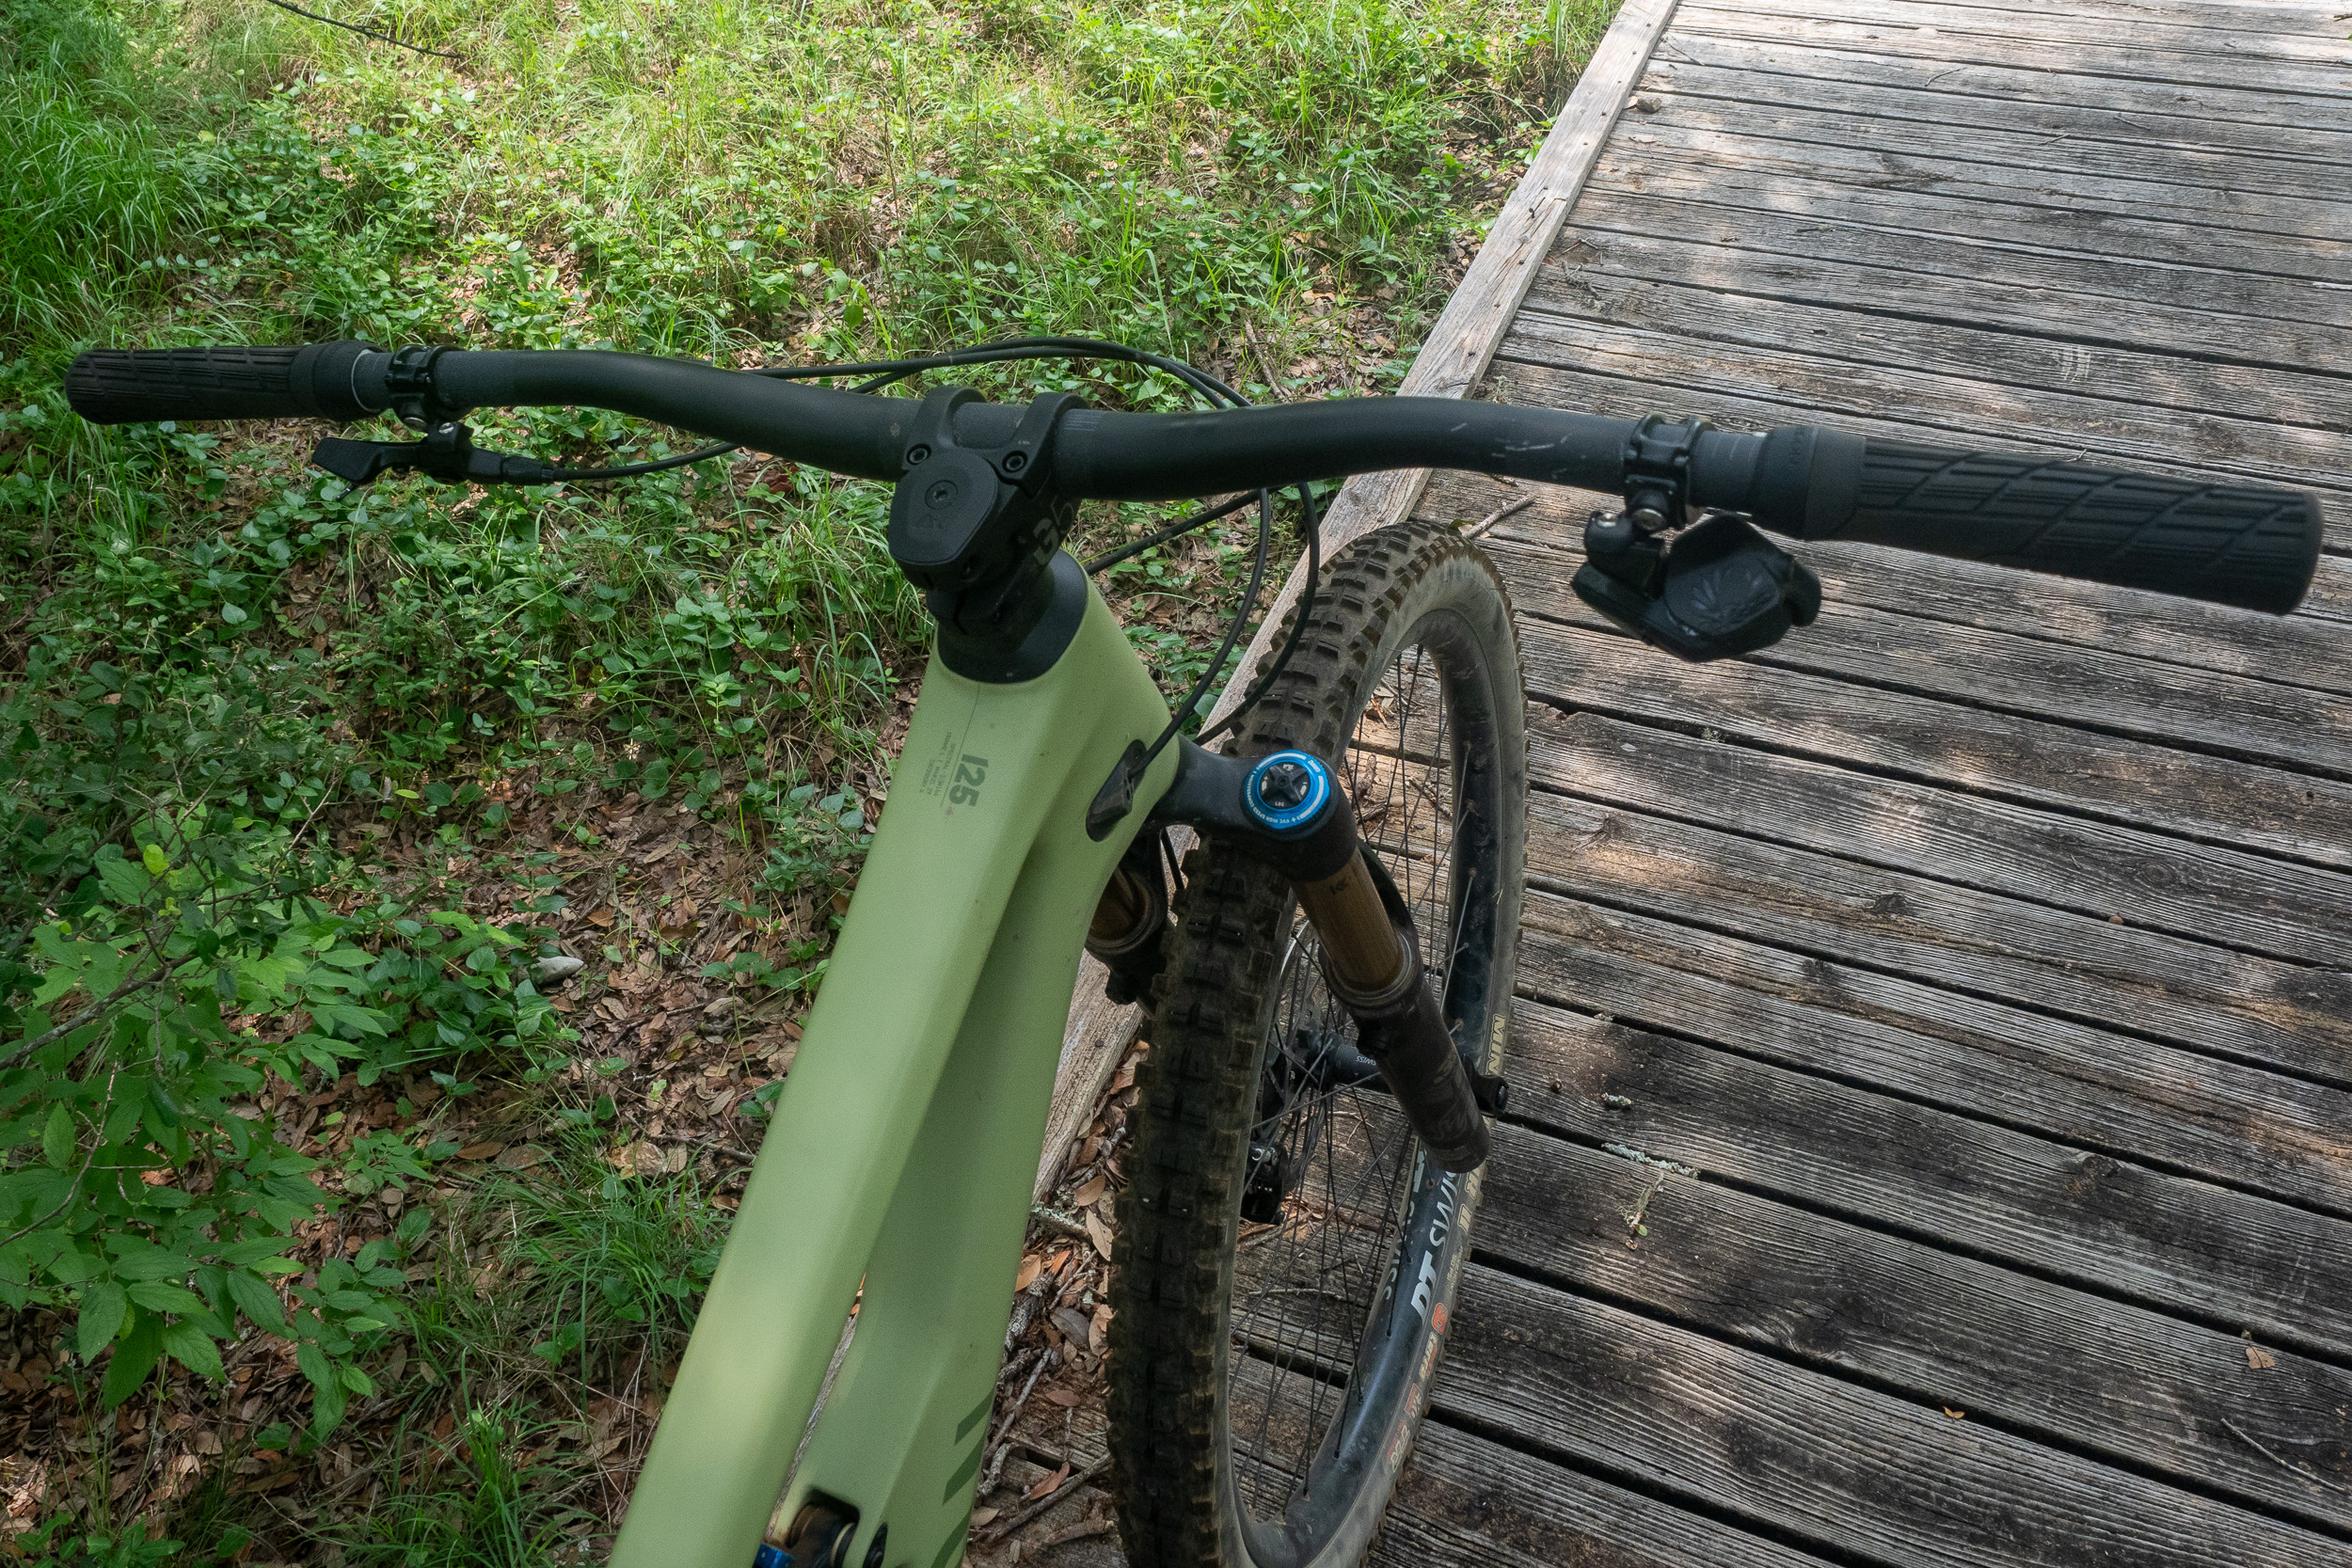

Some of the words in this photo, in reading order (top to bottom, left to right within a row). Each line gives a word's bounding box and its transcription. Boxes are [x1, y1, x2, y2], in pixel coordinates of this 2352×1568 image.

[949, 753, 989, 806] 125
[1253, 807, 1266, 819] SPEED
[1355, 1055, 1376, 1066] SWISS
[1486, 1013, 1505, 1076] MIN
[1411, 1250, 1437, 1327] DT
[1429, 1171, 1457, 1253] SWI
